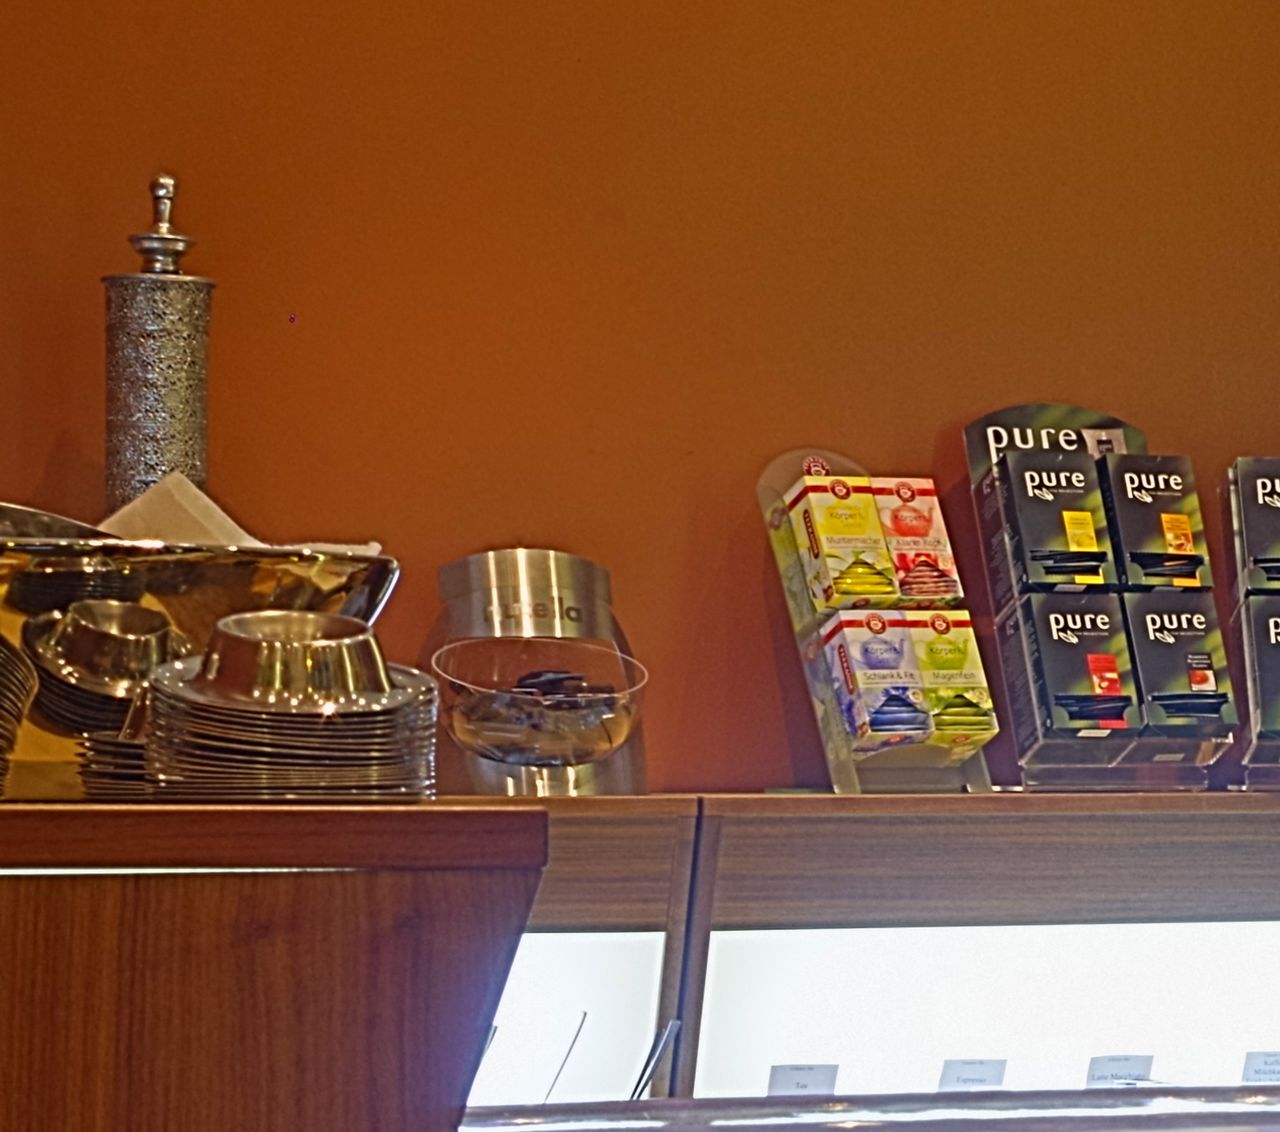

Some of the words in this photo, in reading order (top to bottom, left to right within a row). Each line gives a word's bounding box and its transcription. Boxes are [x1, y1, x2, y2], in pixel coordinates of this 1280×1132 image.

[986, 426, 1078, 466] pure
[1024, 471, 1085, 497] pure
[1124, 473, 1183, 499] pure
[484, 597, 582, 622] uela
[1049, 614, 1110, 640] pure
[1146, 614, 1206, 640] pure
